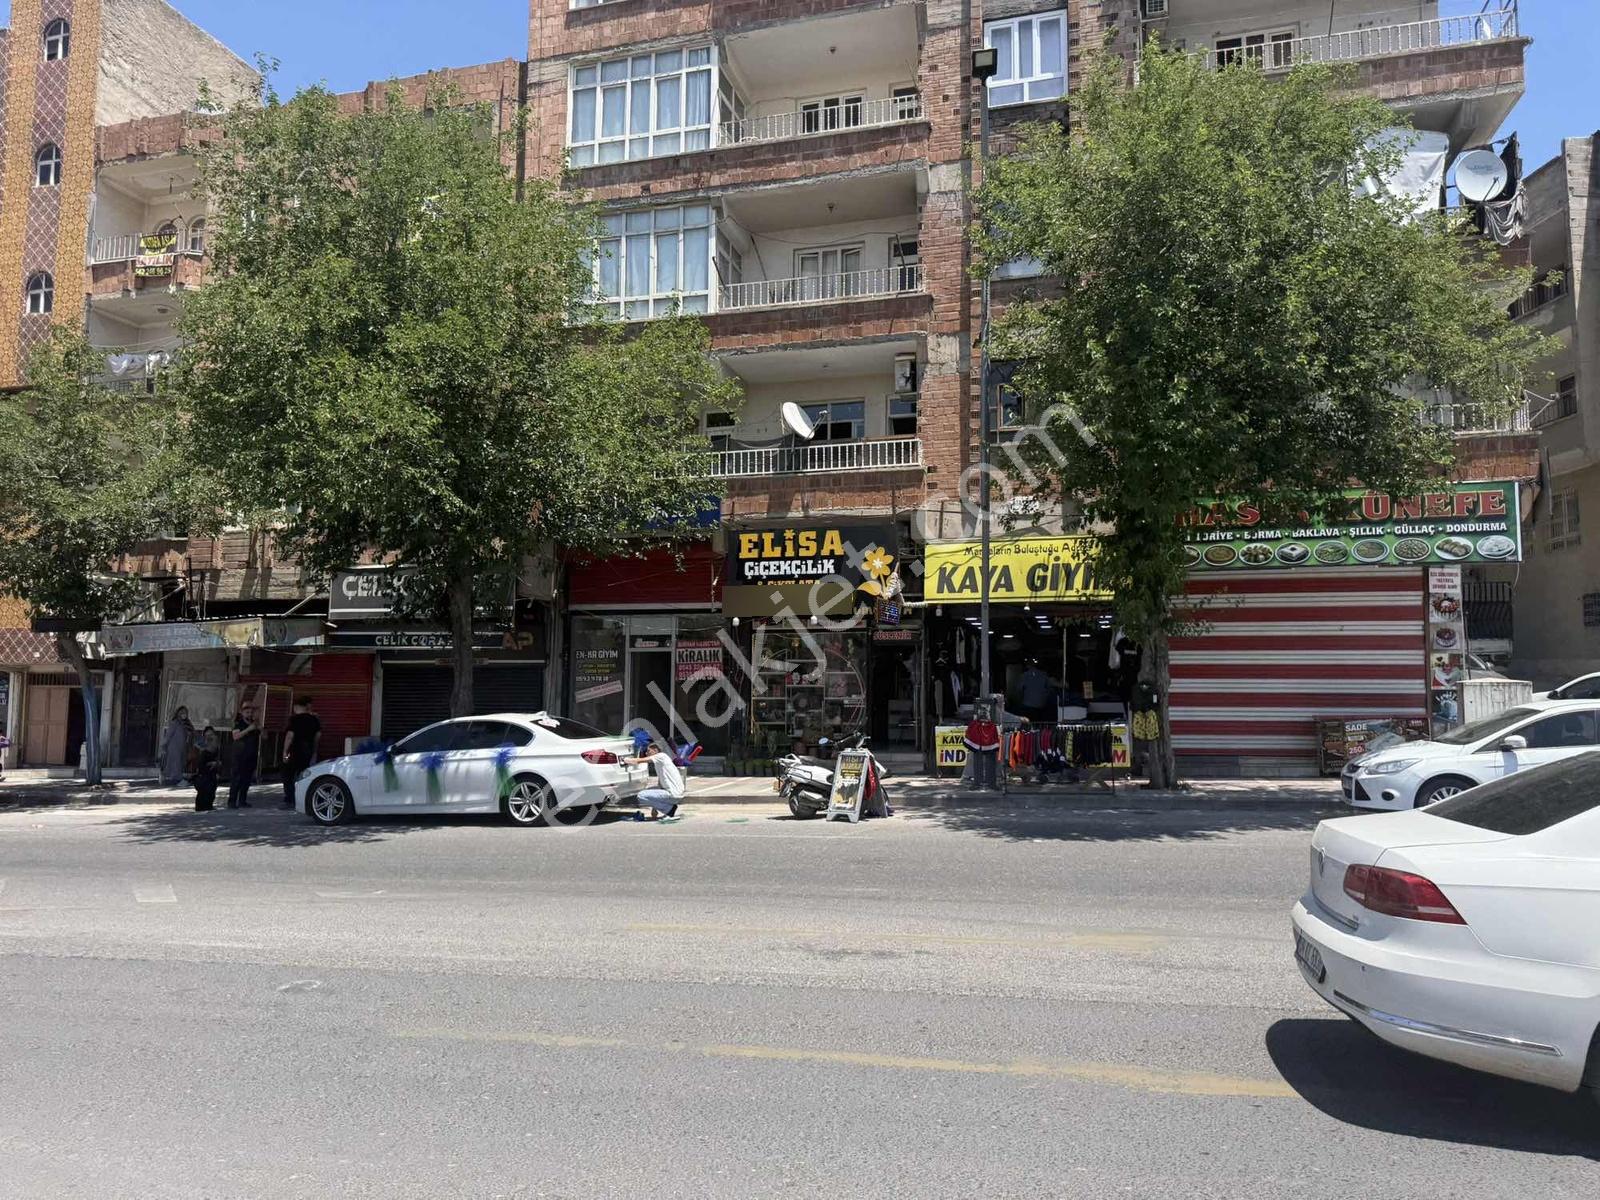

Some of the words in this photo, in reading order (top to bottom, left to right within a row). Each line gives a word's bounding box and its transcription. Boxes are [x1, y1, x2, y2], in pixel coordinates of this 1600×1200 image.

[1394, 523, 1435, 536] GÜLLAÇ
[1446, 522, 1508, 533] DONDURMA
[738, 529, 844, 559] ELİSA
[744, 558, 835, 579] ÇİÇEKÇİLİK
[936, 564, 1015, 594] KAYA
[342, 574, 408, 601] ÇELK
[678, 649, 720, 663] KİRALIK
[940, 749, 969, 763] İND
